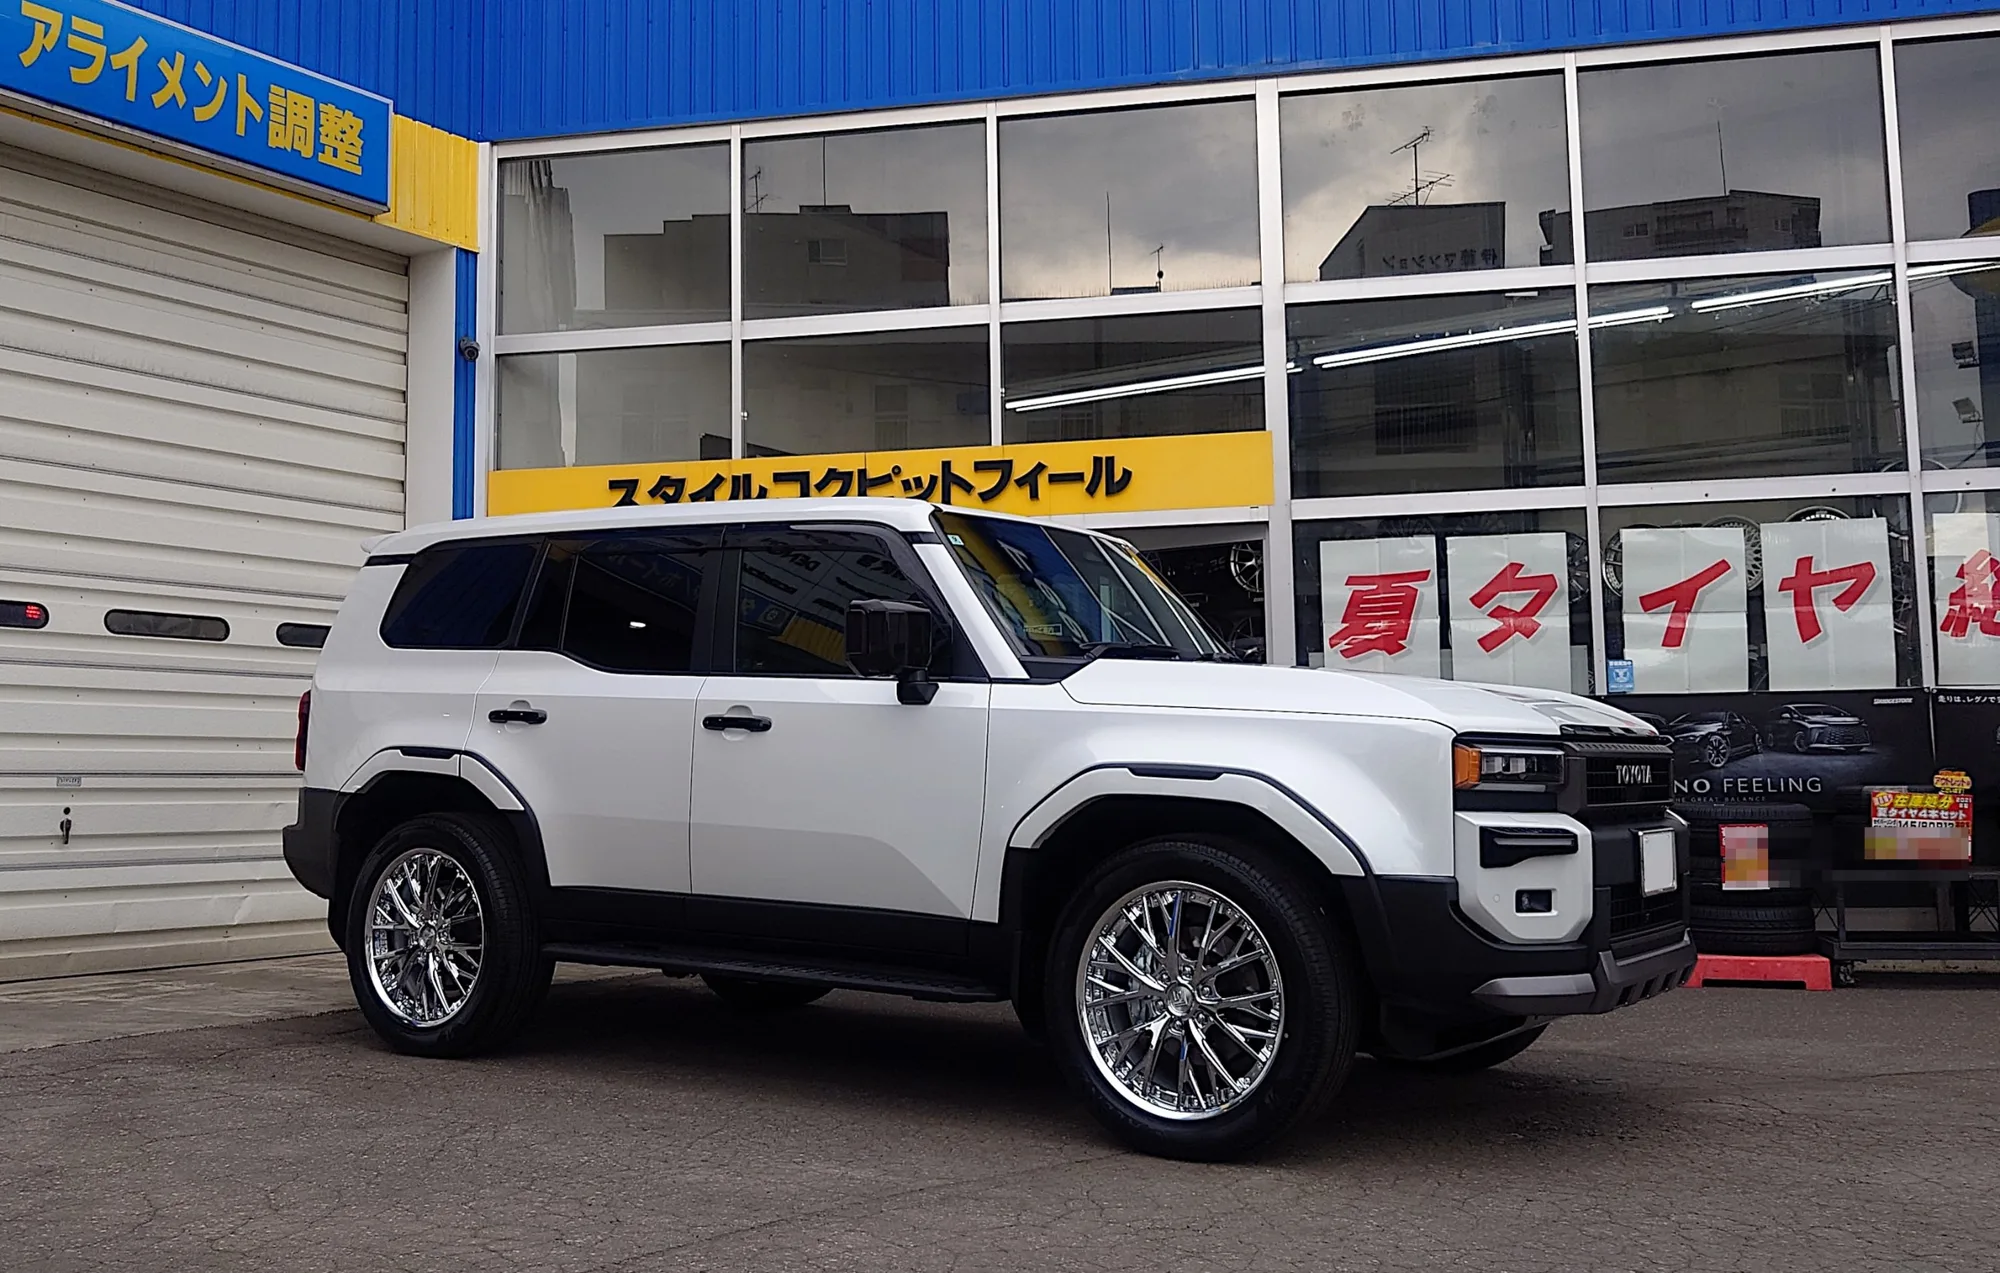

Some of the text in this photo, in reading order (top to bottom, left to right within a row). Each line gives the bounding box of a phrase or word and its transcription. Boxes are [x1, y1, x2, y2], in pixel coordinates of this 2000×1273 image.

[18, 0, 364, 175] アライメント調整
[1616, 765, 1652, 784] TOYOTA
[1673, 777, 1822, 793] NO FEELING
